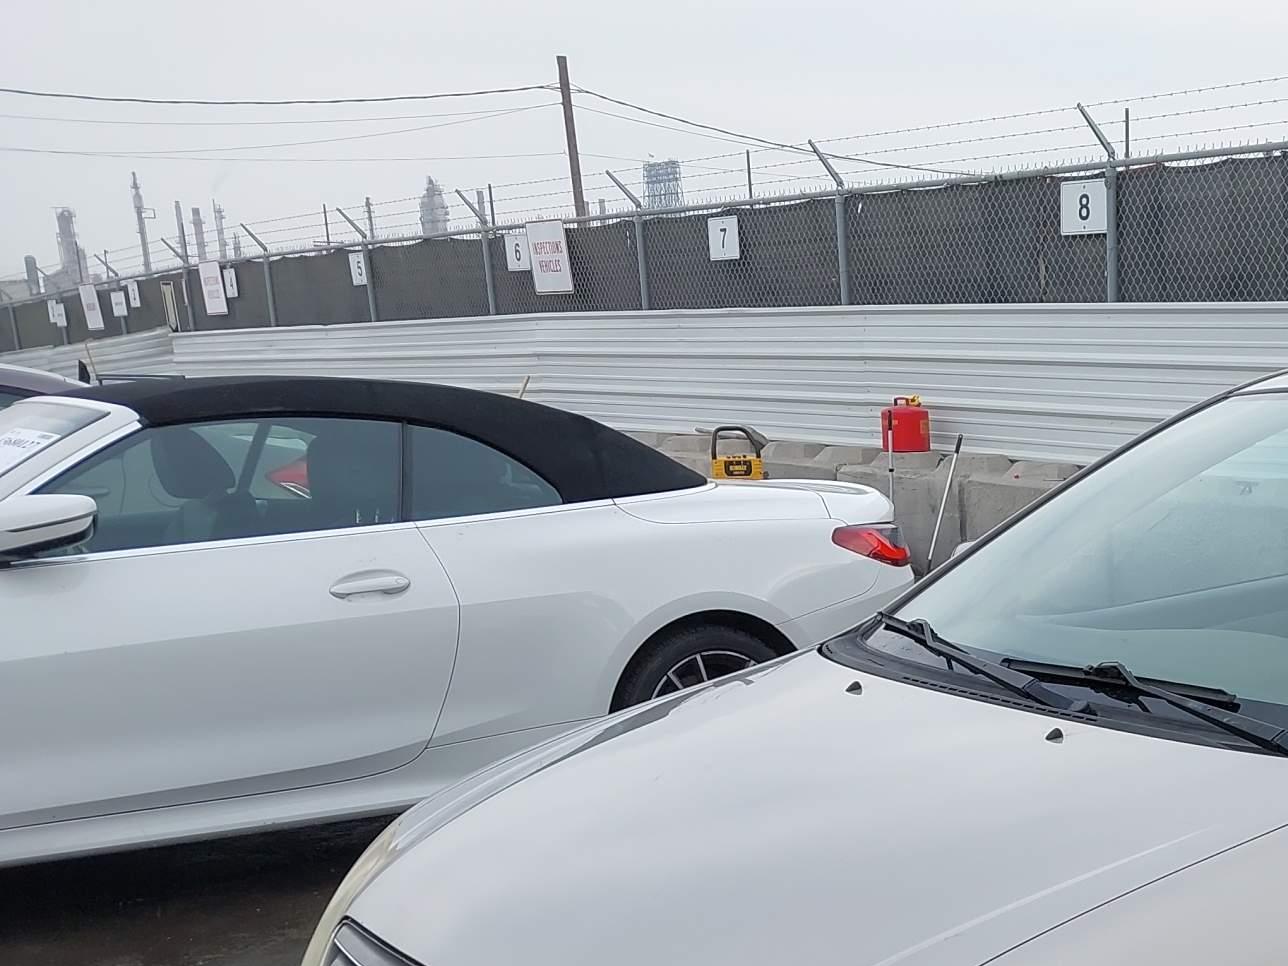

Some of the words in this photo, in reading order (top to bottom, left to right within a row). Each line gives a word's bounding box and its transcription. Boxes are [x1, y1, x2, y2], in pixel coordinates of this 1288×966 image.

[1079, 193, 1090, 221] 8
[719, 227, 727, 249] 7
[514, 243, 521, 261] 6
[532, 241, 563, 255] INSPECTIONS
[357, 260, 363, 277] 5
[539, 259, 561, 273] VEHICLES
